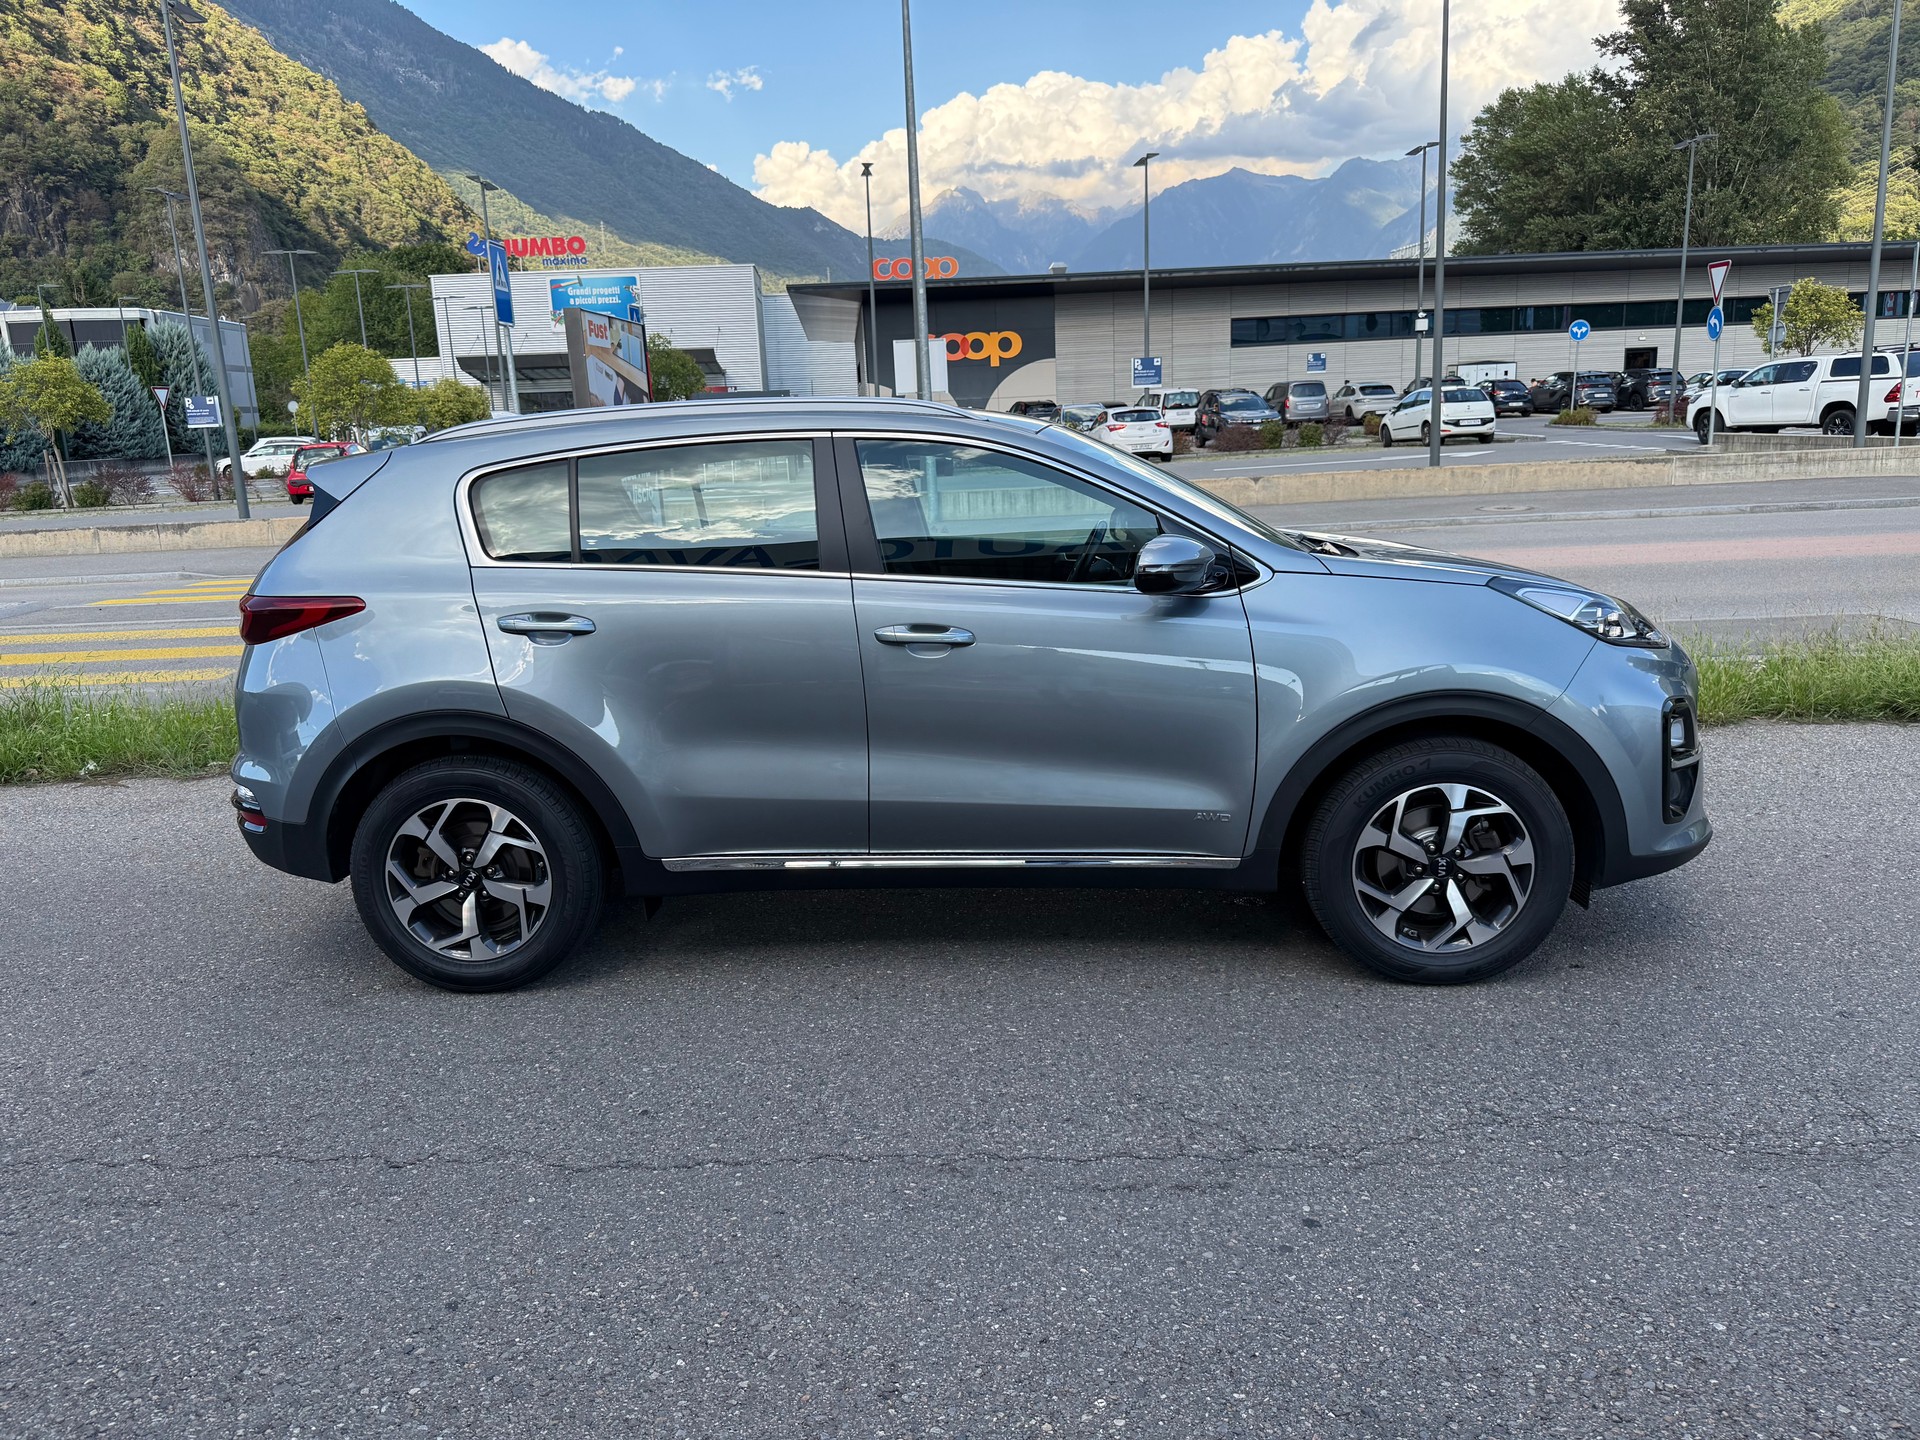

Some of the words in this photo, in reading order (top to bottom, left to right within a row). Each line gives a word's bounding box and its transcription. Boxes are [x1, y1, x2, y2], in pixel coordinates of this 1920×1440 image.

[542, 257, 587, 266] maximo
[567, 286, 592, 296] Grandi
[592, 286, 621, 296] progetti
[575, 296, 598, 306] piccoli
[598, 295, 621, 305] prezzi.
[928, 331, 1023, 367] oop
[1193, 812, 1231, 822] AWD
[1437, 859, 1447, 877] KIA
[462, 871, 477, 887] KIA
